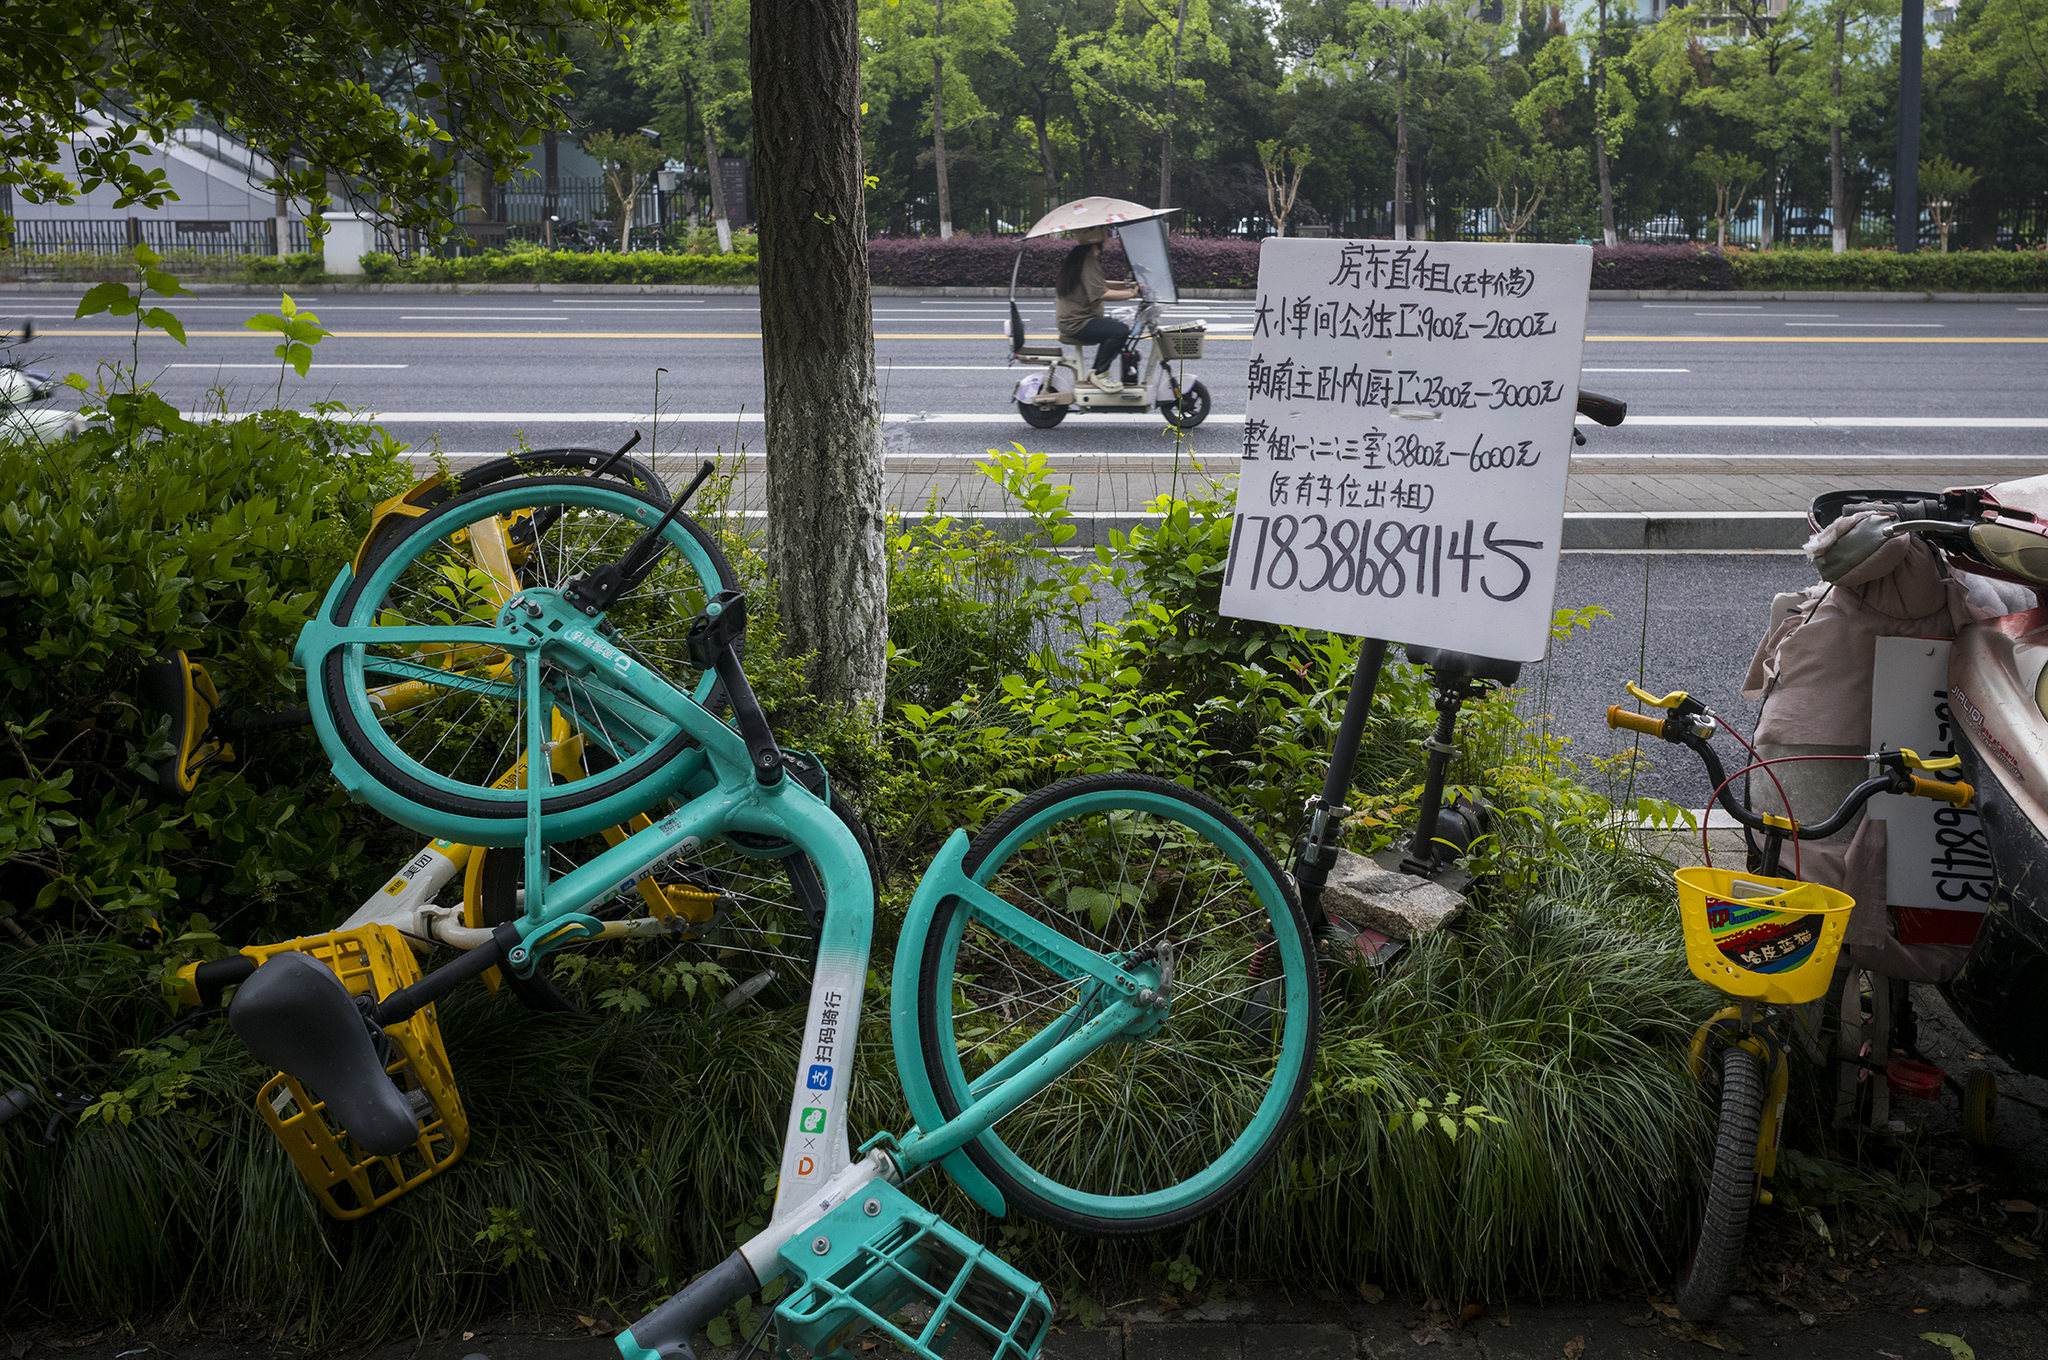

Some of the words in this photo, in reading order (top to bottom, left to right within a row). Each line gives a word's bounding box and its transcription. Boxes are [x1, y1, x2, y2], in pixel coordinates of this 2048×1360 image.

[1224, 512, 1544, 602] 17838689145
[402, 853, 433, 881] 美团
[1740, 930, 1813, 965] 哈皮蓝猫
[815, 991, 842, 1063] 扫码骑行
